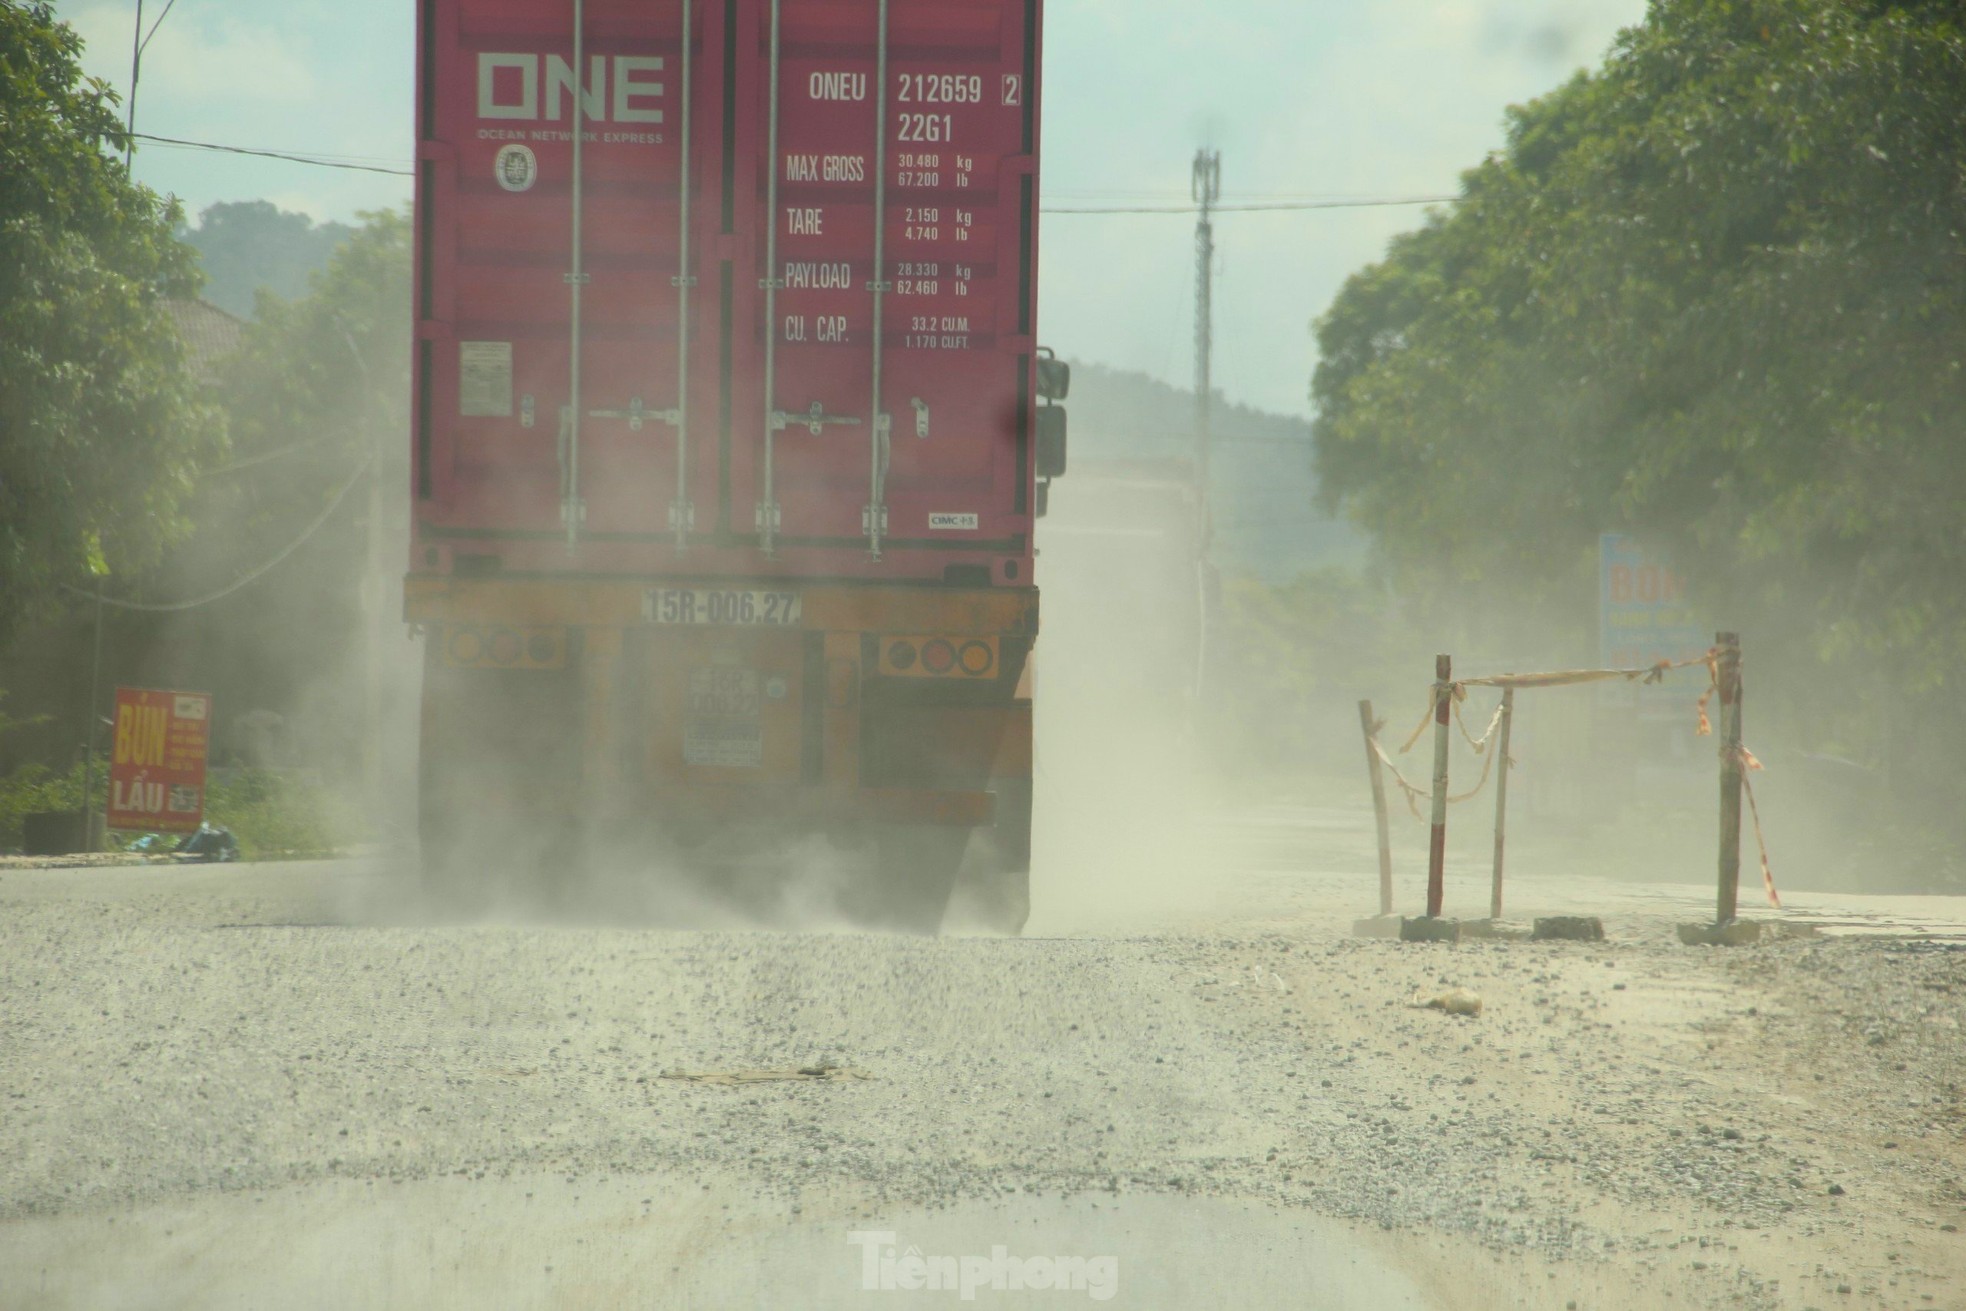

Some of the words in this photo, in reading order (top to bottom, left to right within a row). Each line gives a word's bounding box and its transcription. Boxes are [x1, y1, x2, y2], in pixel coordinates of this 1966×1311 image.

[476, 52, 664, 123] ONE
[809, 72, 866, 100] ONEU
[898, 74, 982, 103] 212659
[1004, 76, 1018, 104] 2
[478, 128, 525, 140] OCEAN
[532, 130, 597, 142] NETWRK
[604, 131, 663, 144] EXPRESS
[898, 114, 951, 142] 22G1
[786, 155, 818, 181] MAX
[822, 155, 864, 181] GROSS
[898, 154, 939, 168] 30.480
[956, 155, 972, 172] kg
[898, 172, 939, 187] 67.200
[956, 172, 968, 188] lb
[786, 208, 823, 235] TARE
[905, 208, 939, 223] 2.150
[956, 208, 972, 227] kg
[905, 226, 938, 241] 4.740
[956, 226, 968, 242] lb
[785, 263, 851, 289] PAYLOAD
[897, 263, 938, 277] 28.330
[955, 264, 971, 281] kg
[897, 280, 938, 295] 62.460
[955, 280, 967, 296] lb
[785, 315, 807, 341] CU.
[817, 316, 849, 342] CAP.
[911, 317, 937, 332] 33.2
[905, 334, 937, 349] 1.170
[931, 516, 959, 525] CIMC
[116, 693, 168, 766] BÚN
